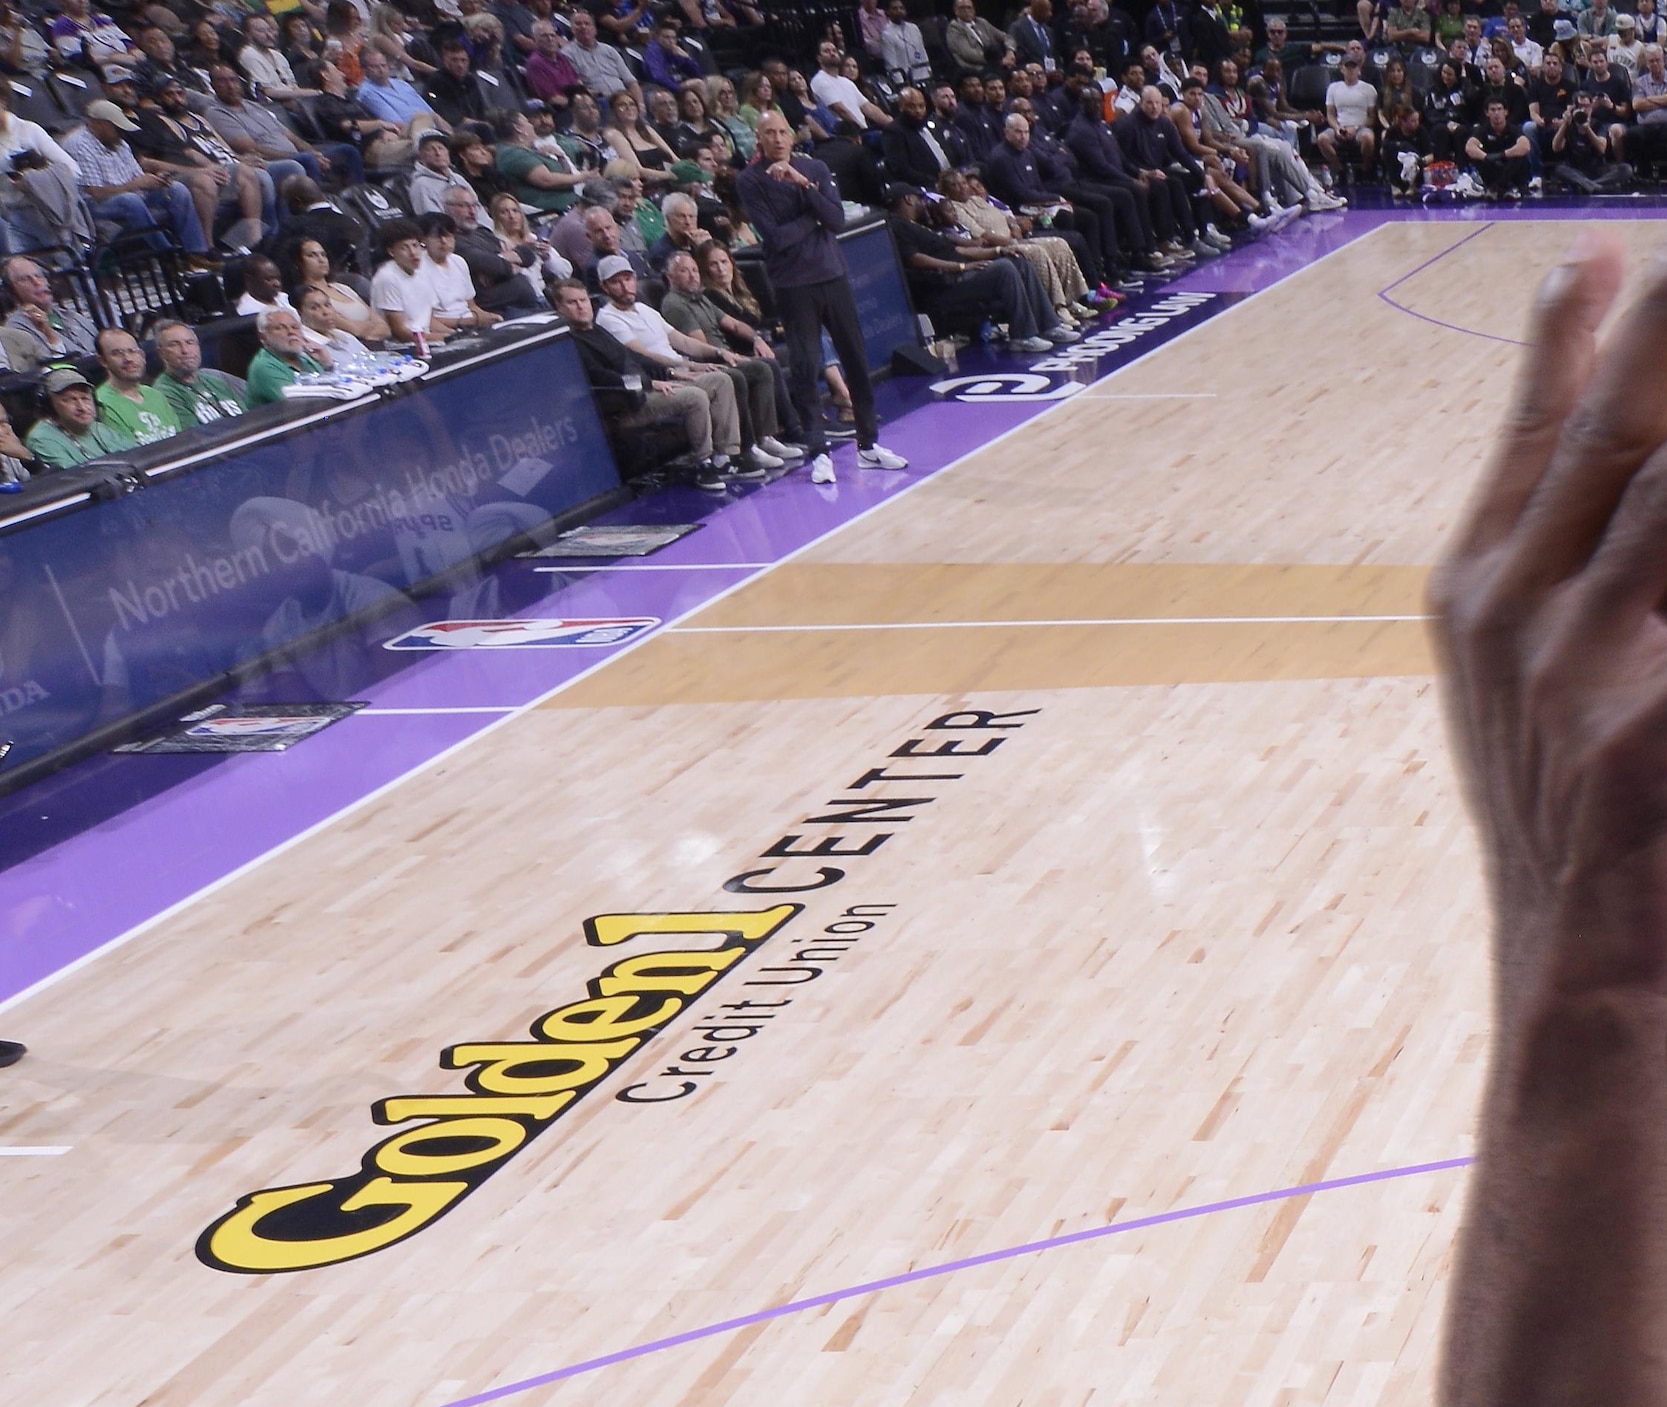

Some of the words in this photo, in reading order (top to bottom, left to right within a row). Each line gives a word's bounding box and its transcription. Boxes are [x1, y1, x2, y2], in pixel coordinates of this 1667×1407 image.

[1029, 317, 1170, 371] PHOONG
[1135, 292, 1217, 317] LAW
[106, 545, 270, 631] Northern
[270, 482, 408, 563] California
[405, 442, 492, 507] Honda
[488, 415, 578, 472] Dealers
[723, 708, 1042, 893] CENTER
[615, 999, 793, 1103] Credit
[742, 903, 898, 986] Union
